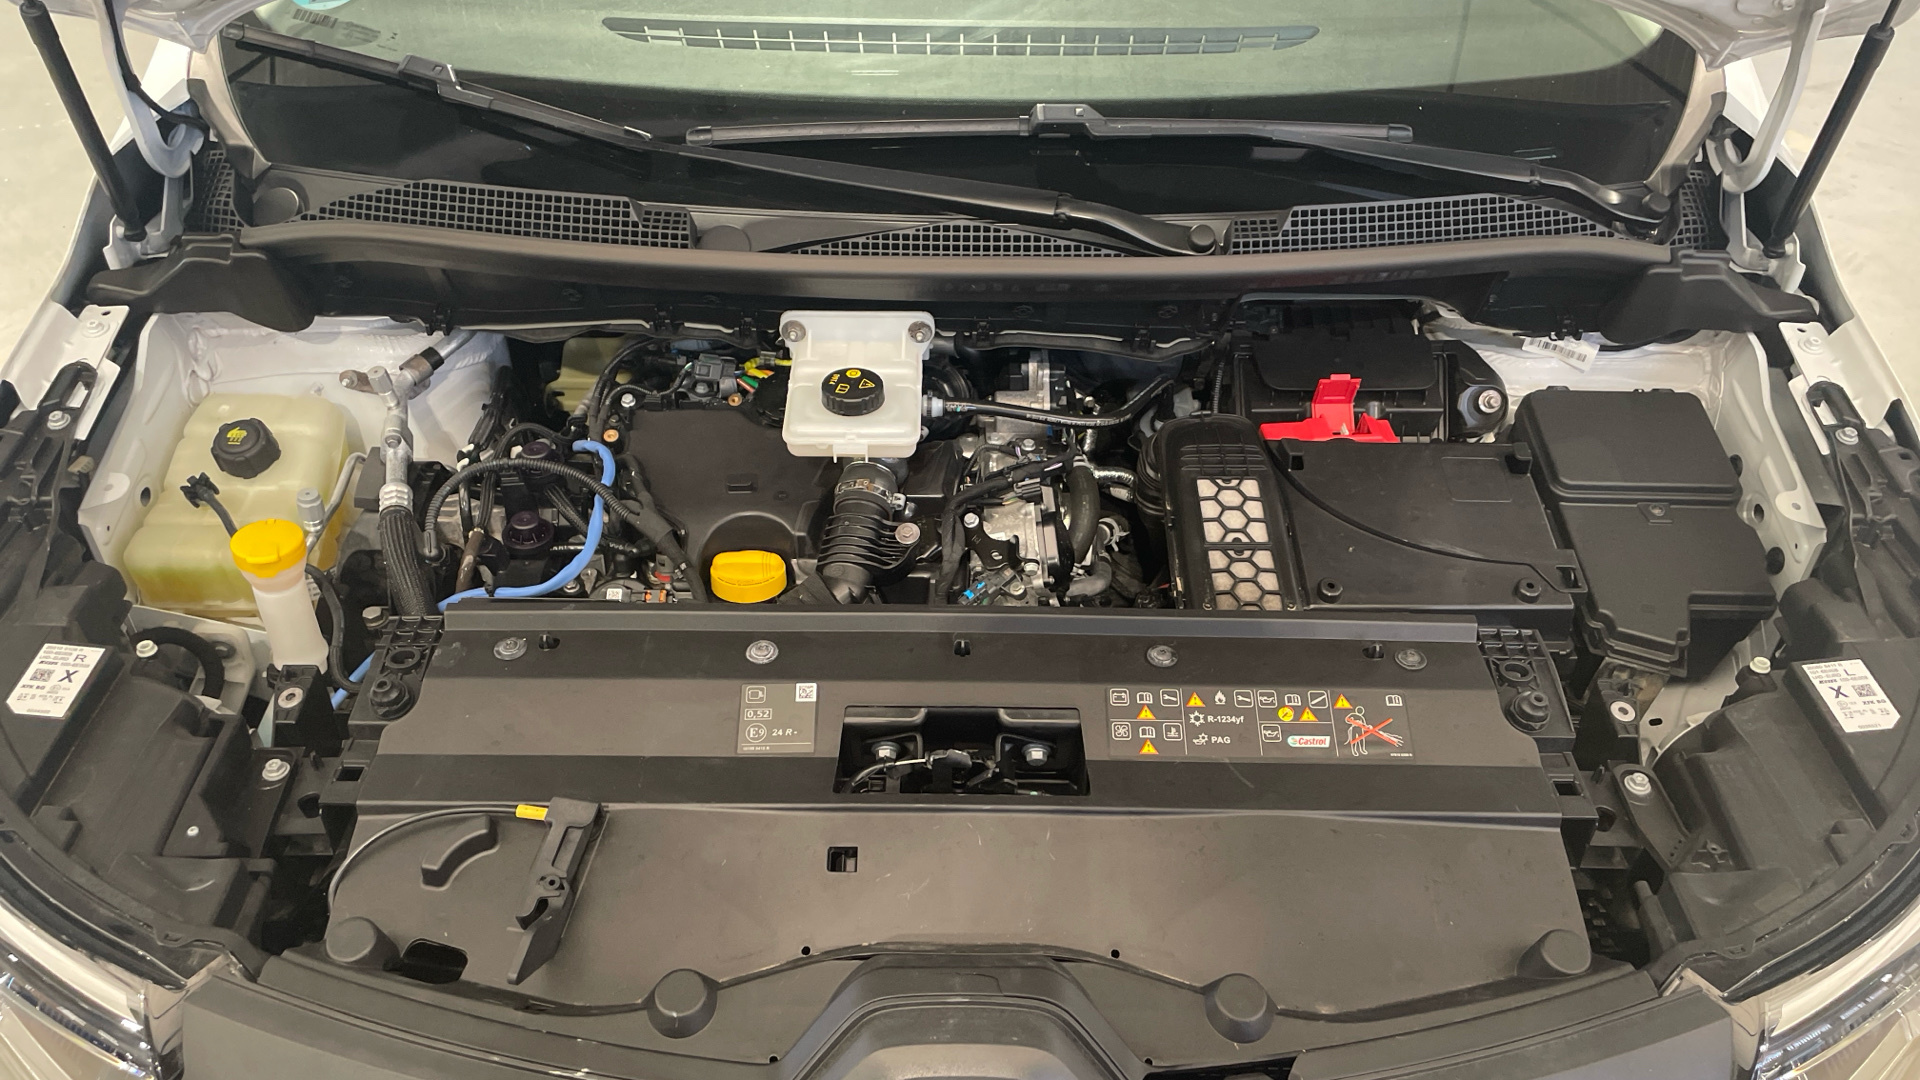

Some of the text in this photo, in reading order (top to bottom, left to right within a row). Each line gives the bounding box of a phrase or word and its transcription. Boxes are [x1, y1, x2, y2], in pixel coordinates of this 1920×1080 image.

[73, 654, 87, 662] R
[57, 669, 79, 683] X
[1843, 668, 1856, 676] L
[1828, 685, 1850, 699] X
[747, 710, 770, 719] 0,52
[1207, 715, 1245, 725] R-1234yf
[771, 728, 783, 736] 24
[1211, 736, 1231, 744] PAG
[1298, 737, 1327, 746] Castrol
